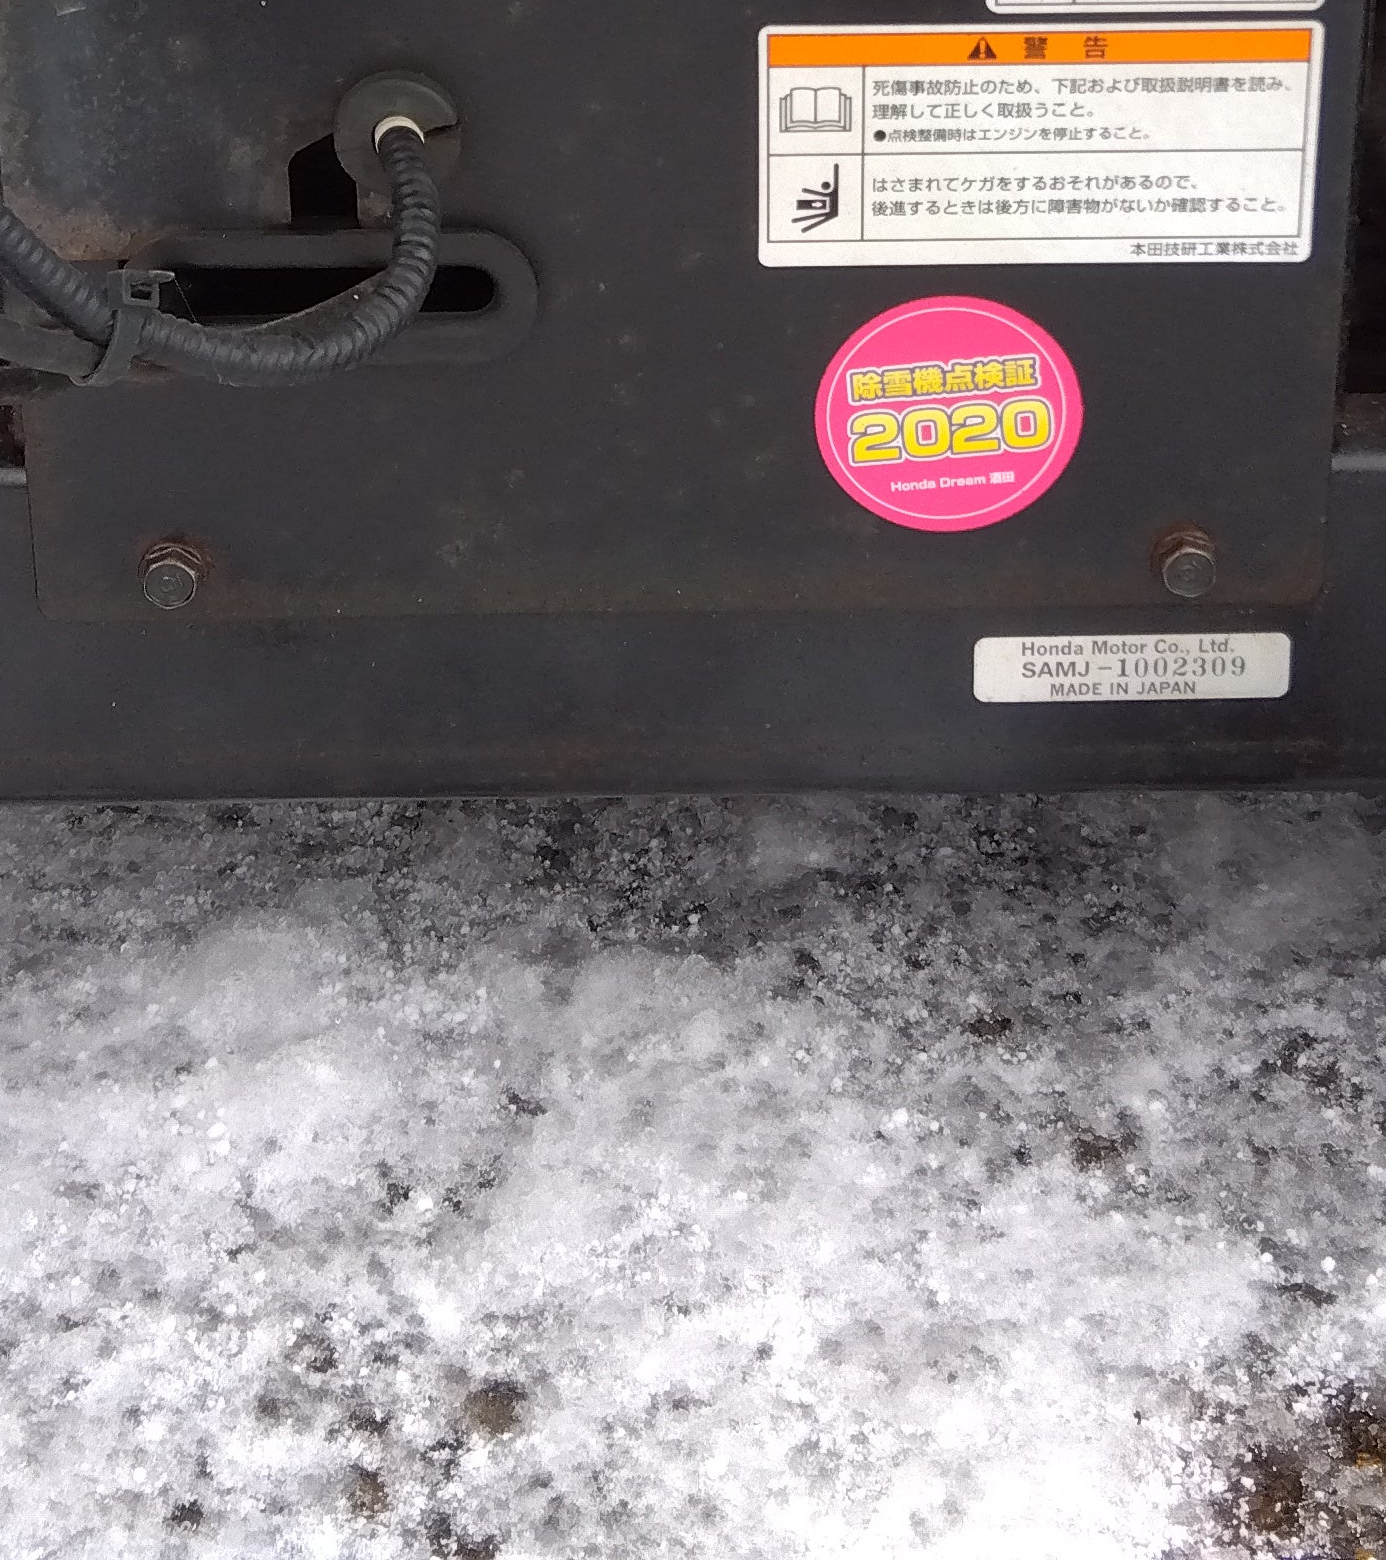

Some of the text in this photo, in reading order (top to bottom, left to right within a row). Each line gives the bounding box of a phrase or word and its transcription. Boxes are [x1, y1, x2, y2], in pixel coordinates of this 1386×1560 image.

[1023, 36, 1108, 59] 警告
[871, 100, 1094, 120] 理解して正しく取扱うこと。
[872, 175, 1197, 192] はさまれてケガをするおそれがあるので、
[871, 197, 1285, 217] 後進するときは後方に障害物がないか確認すること。
[1130, 242, 1299, 257] 本田技研工業株式会社
[850, 358, 1038, 403] 除雪機点検証
[851, 398, 1051, 465] 2020
[890, 479, 936, 492] Honda
[939, 476, 986, 488] Dream
[1021, 639, 1235, 657] Honda Motor Co., Ltd.
[1050, 681, 1196, 697] MADE IN JAPAN
